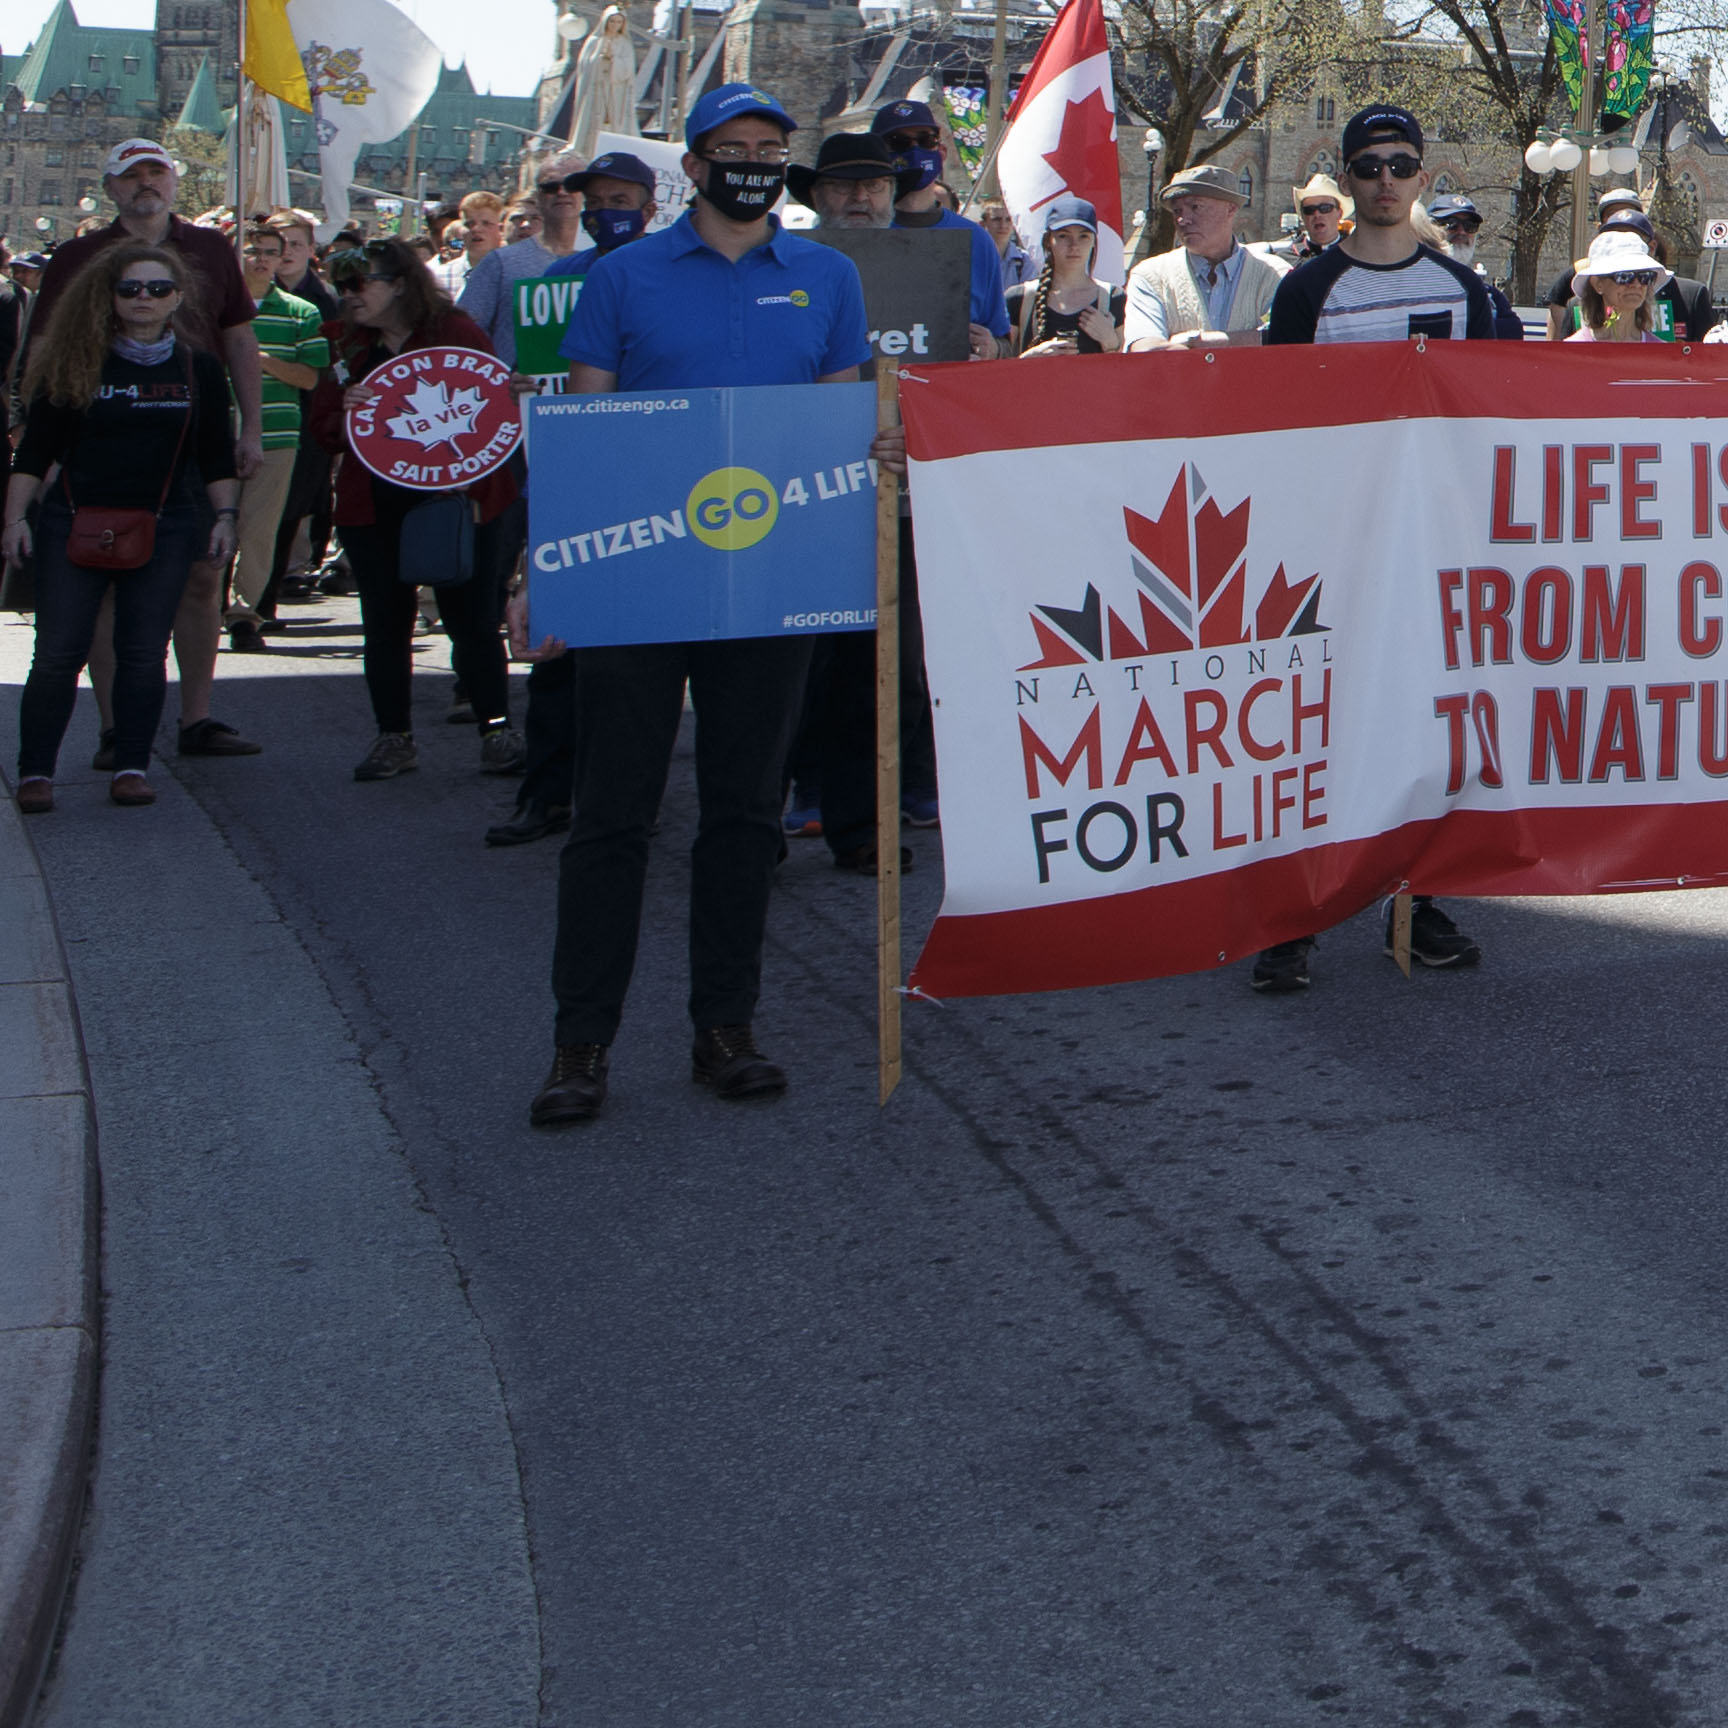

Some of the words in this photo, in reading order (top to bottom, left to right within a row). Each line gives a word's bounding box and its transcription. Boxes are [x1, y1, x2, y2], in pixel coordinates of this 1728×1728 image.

[725, 172, 745, 186] YOU
[736, 191, 766, 205] ALONE
[375, 356, 433, 388] TON
[444, 354, 510, 387] BRAS
[405, 417, 433, 436] la
[435, 401, 474, 424] vie
[536, 399, 690, 416] www.citizengo.ca
[390, 460, 444, 483] SAIT
[448, 421, 520, 480] PORTER
[782, 477, 810, 507] 4
[1489, 443, 1663, 544] LIFE
[783, 608, 878, 628] #GOFORLIF
[1437, 563, 1647, 670] FROM
[1014, 639, 1333, 705] NATIONAL
[1018, 668, 1332, 801] MARCH
[1434, 688, 1504, 797] TO
[1030, 791, 1190, 884] FOR
[1212, 759, 1328, 852] LIFE
